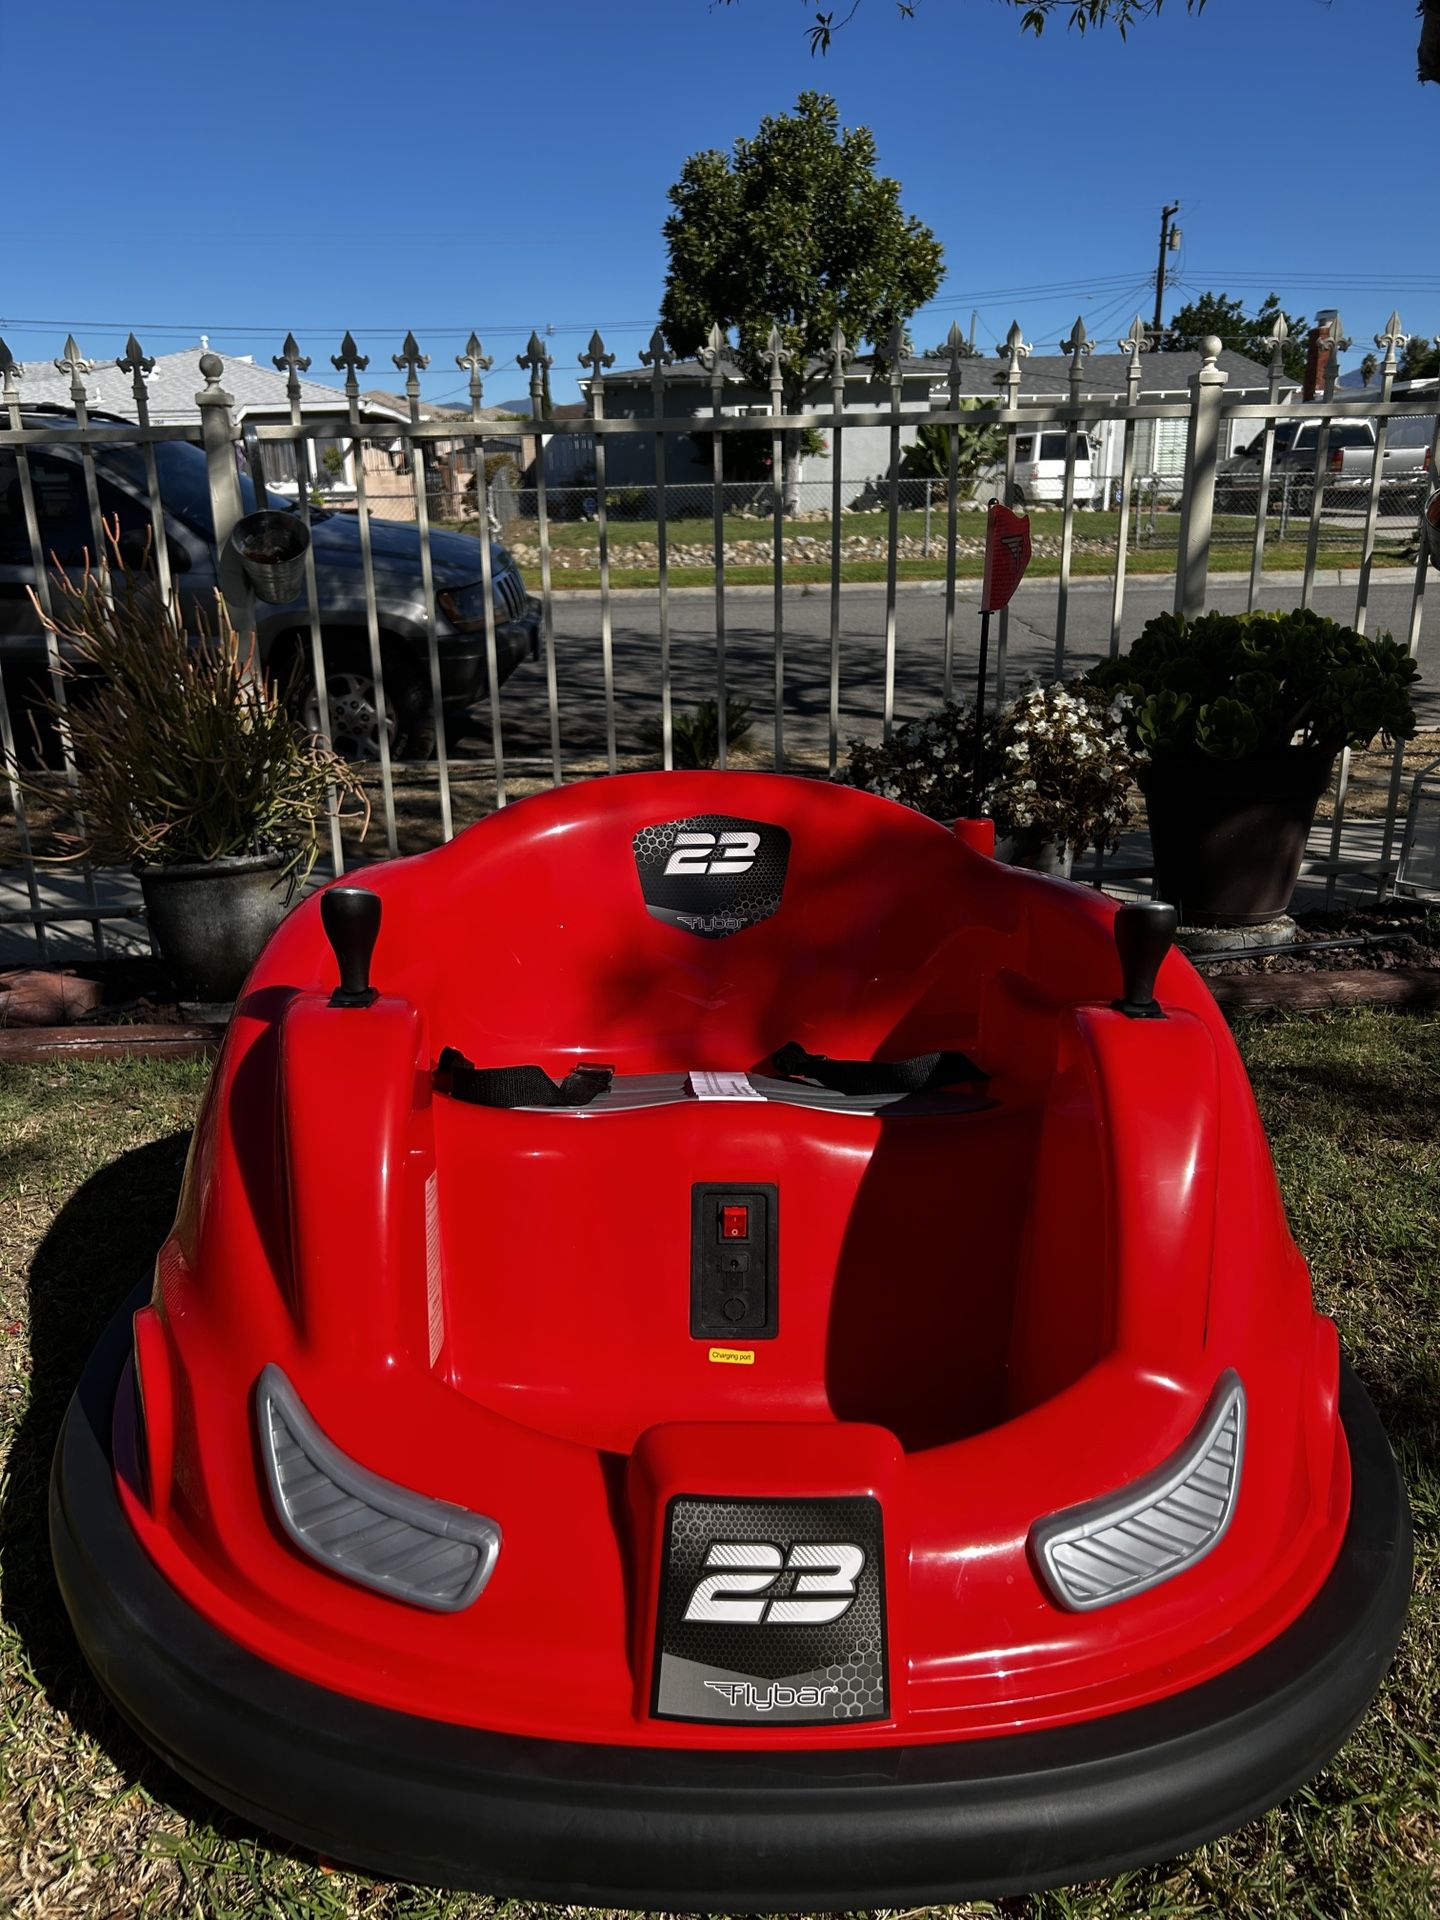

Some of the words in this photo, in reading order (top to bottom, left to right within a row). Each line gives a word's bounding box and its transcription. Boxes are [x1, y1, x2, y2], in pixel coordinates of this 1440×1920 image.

[663, 831, 761, 876] 23
[711, 1351, 739, 1361] Charging
[739, 1353, 752, 1361] port
[681, 1542, 866, 1625] 23
